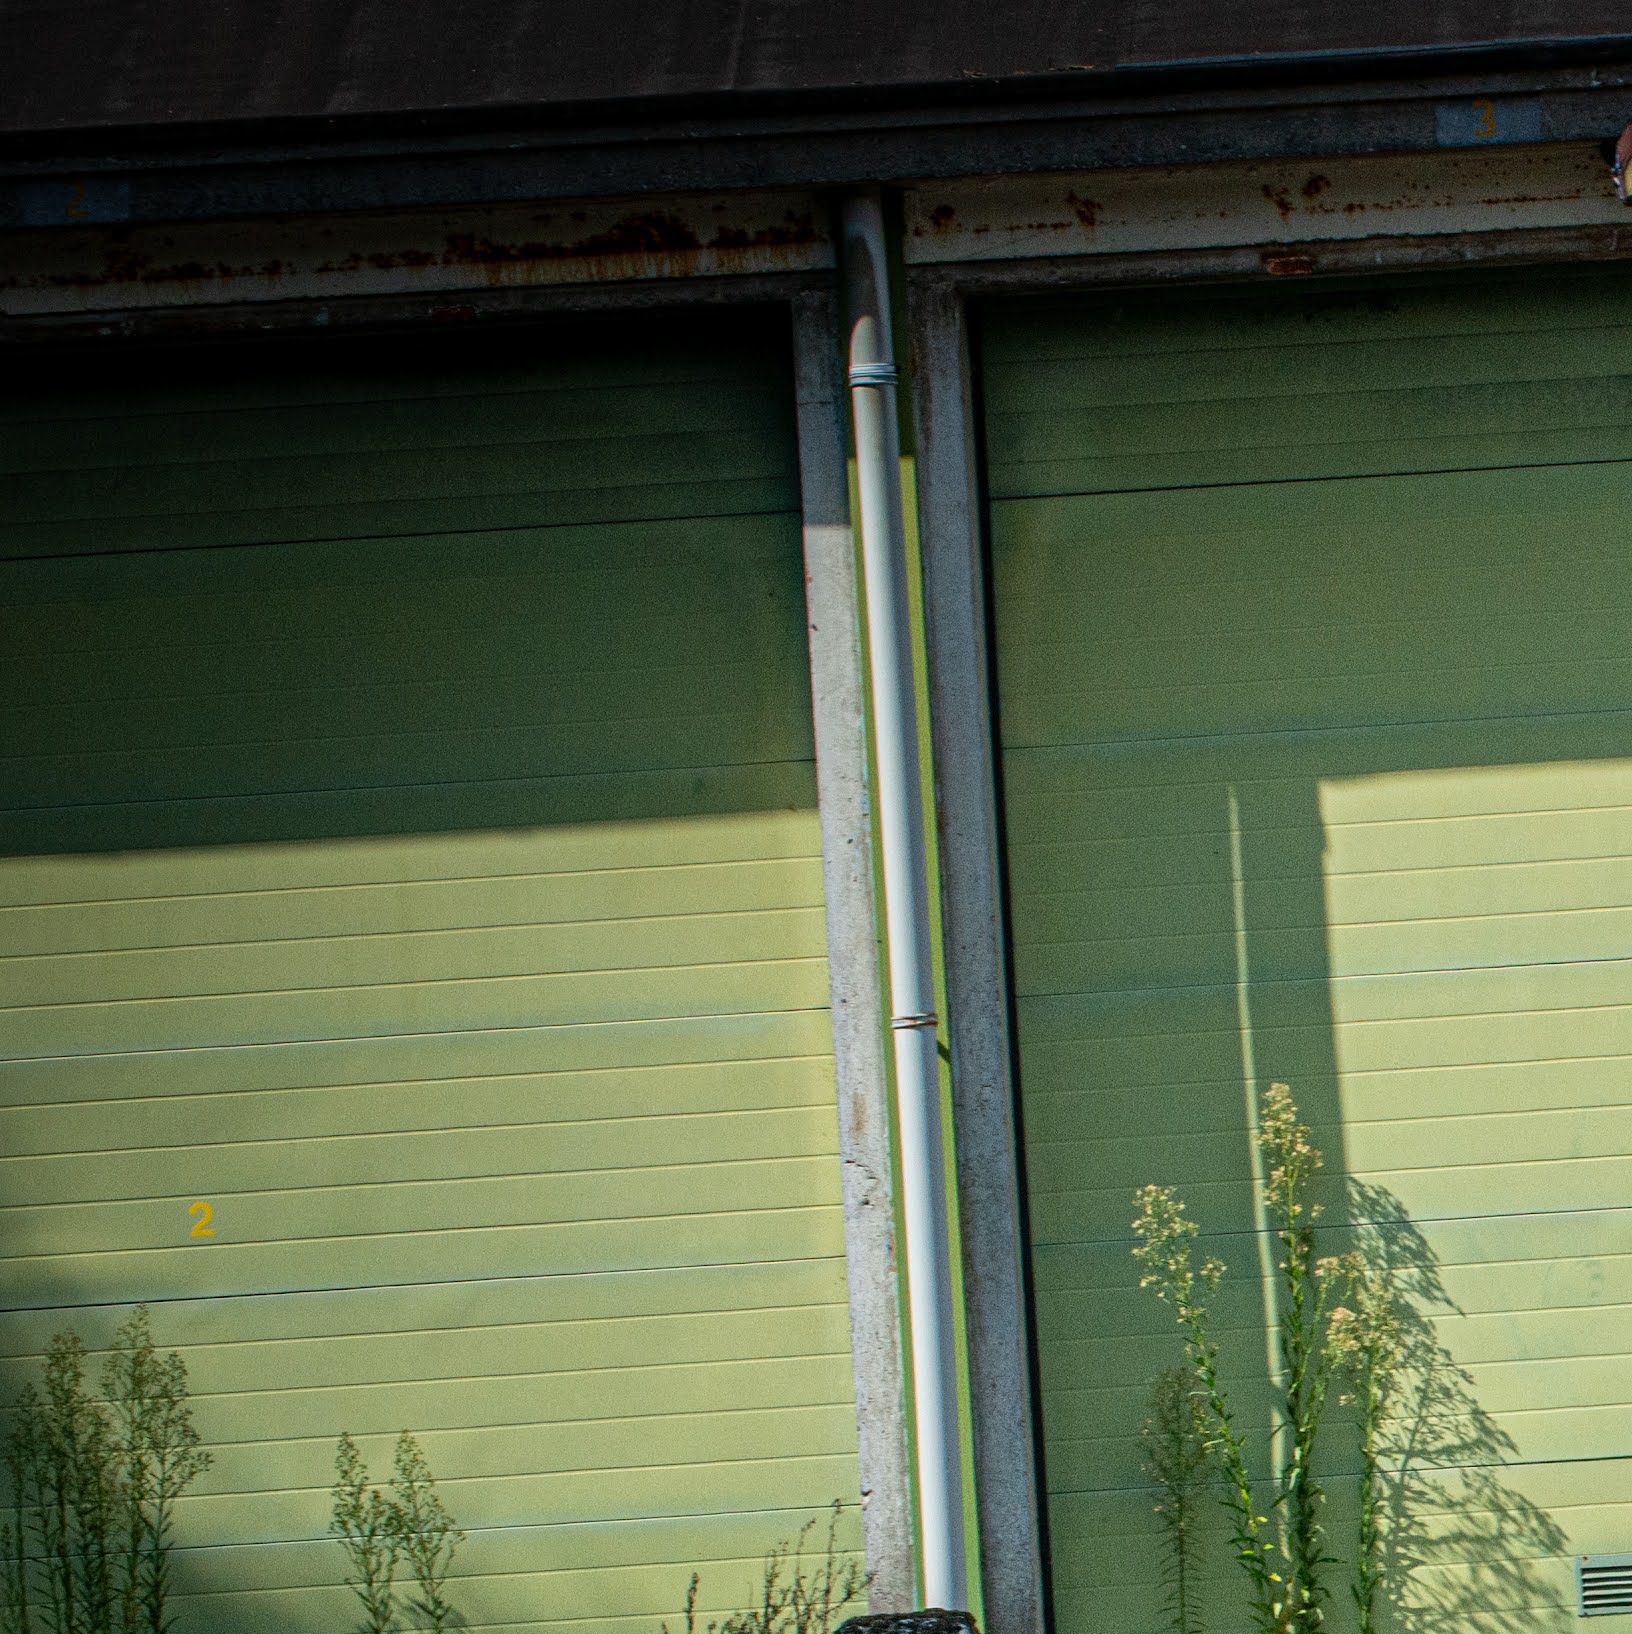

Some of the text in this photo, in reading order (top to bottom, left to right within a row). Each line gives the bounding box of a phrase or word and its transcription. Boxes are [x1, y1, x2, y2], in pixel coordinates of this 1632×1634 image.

[1472, 97, 1496, 139] 3
[63, 177, 90, 218] 2
[189, 1202, 217, 1237] 2
